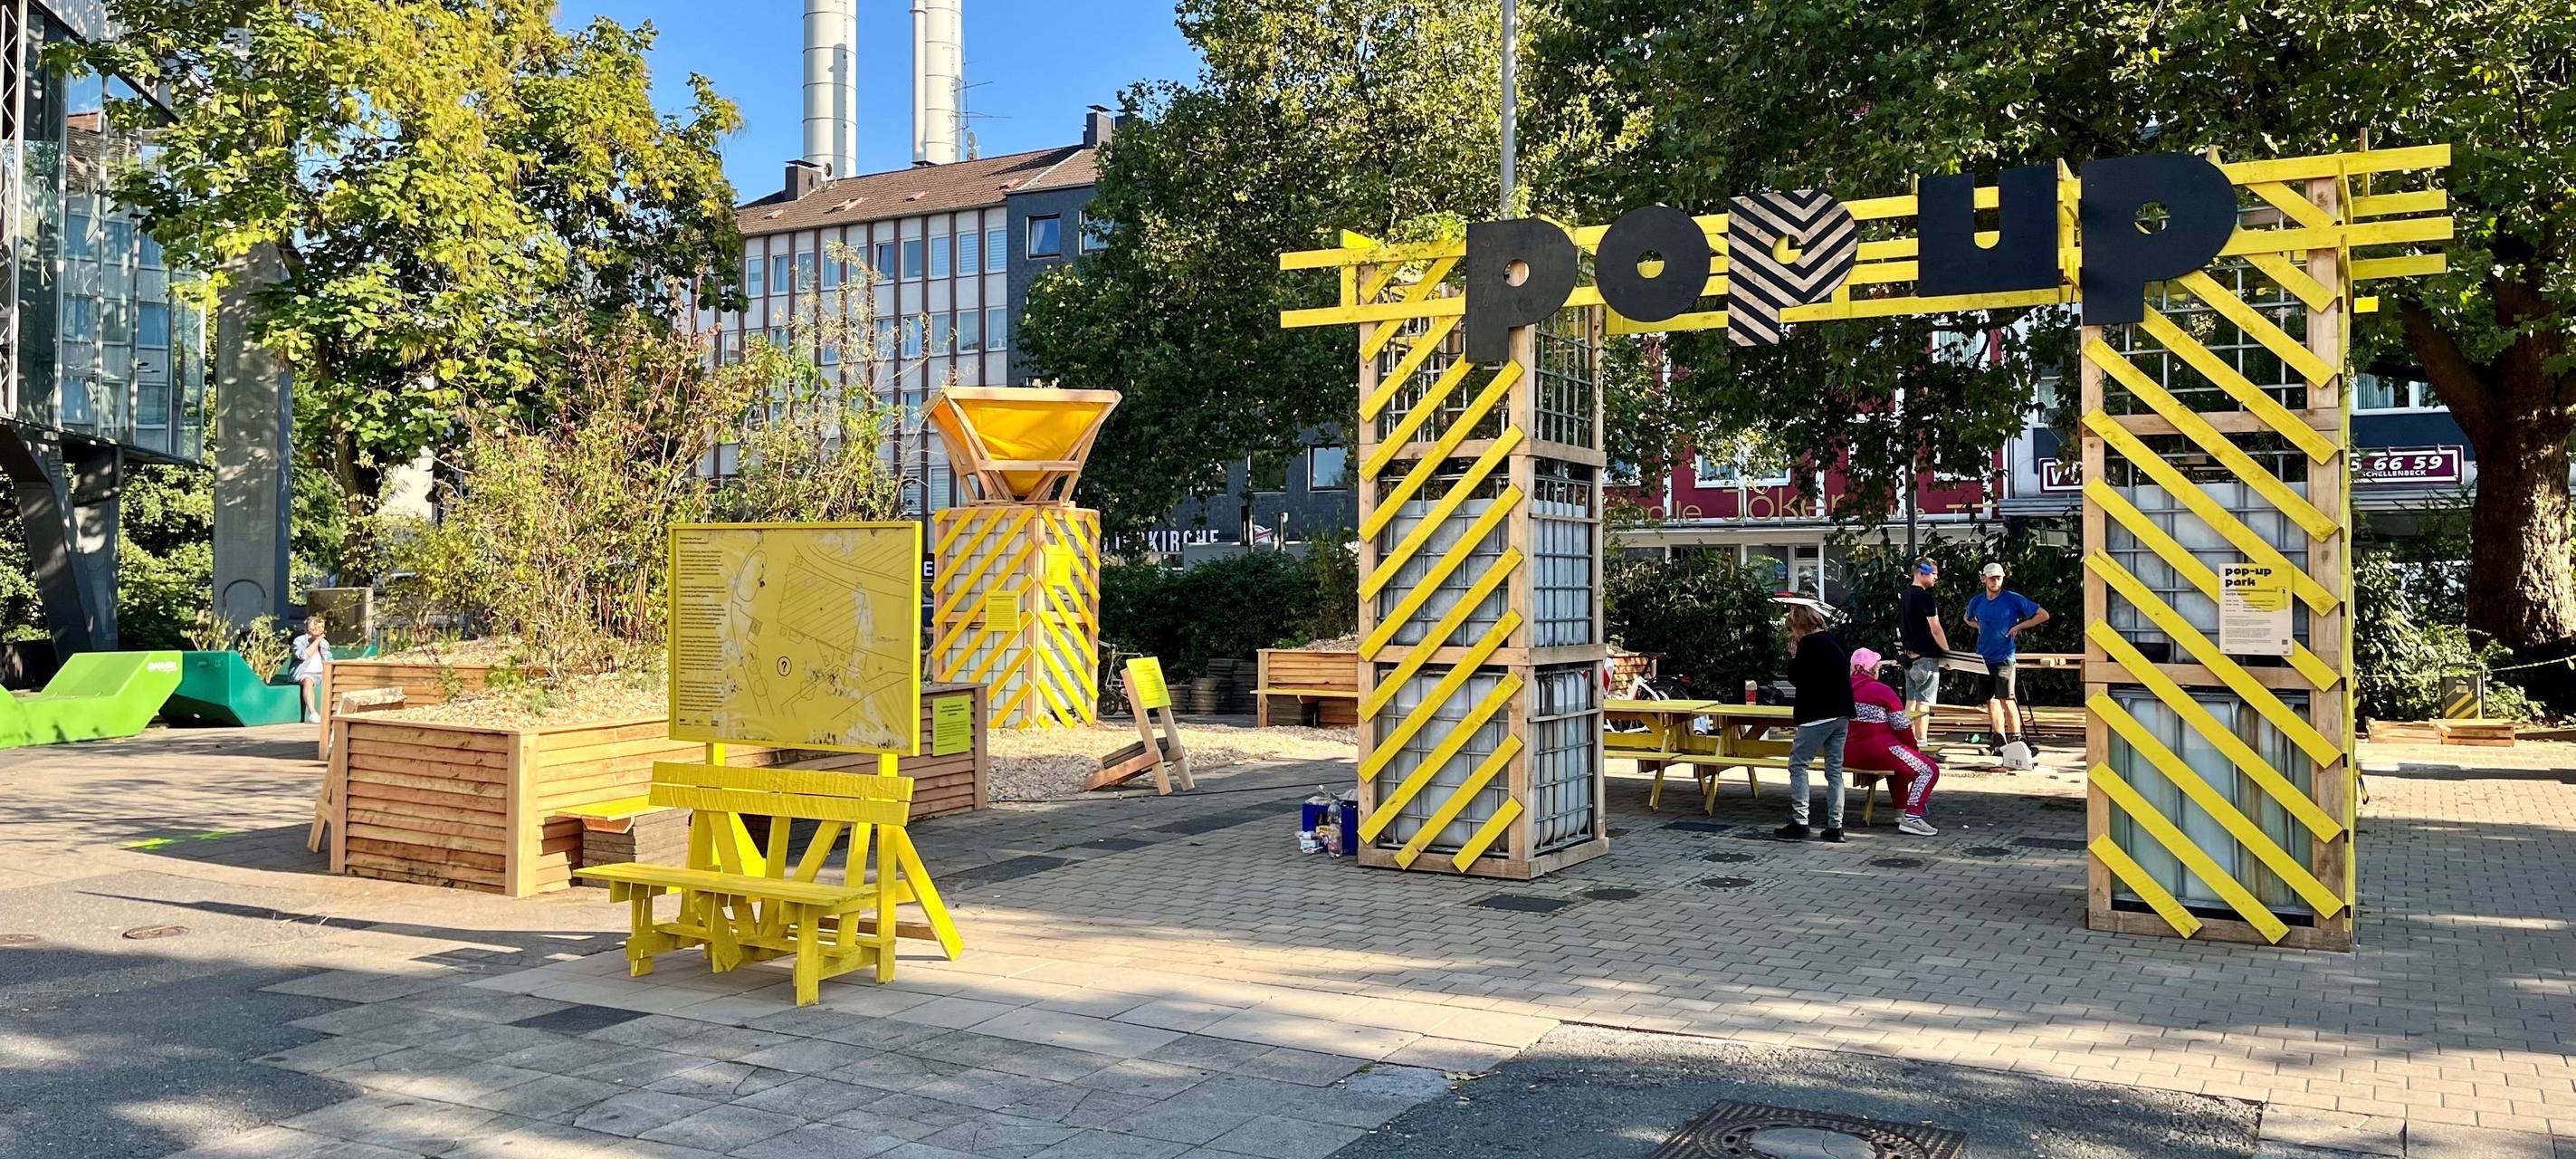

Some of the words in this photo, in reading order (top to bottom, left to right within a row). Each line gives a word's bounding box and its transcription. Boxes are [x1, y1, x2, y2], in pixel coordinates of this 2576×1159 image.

[2373, 456, 2404, 471] 66
[2412, 455, 2443, 470] 59
[2225, 568, 2272, 577] pop-up
[2225, 578, 2256, 588] park
